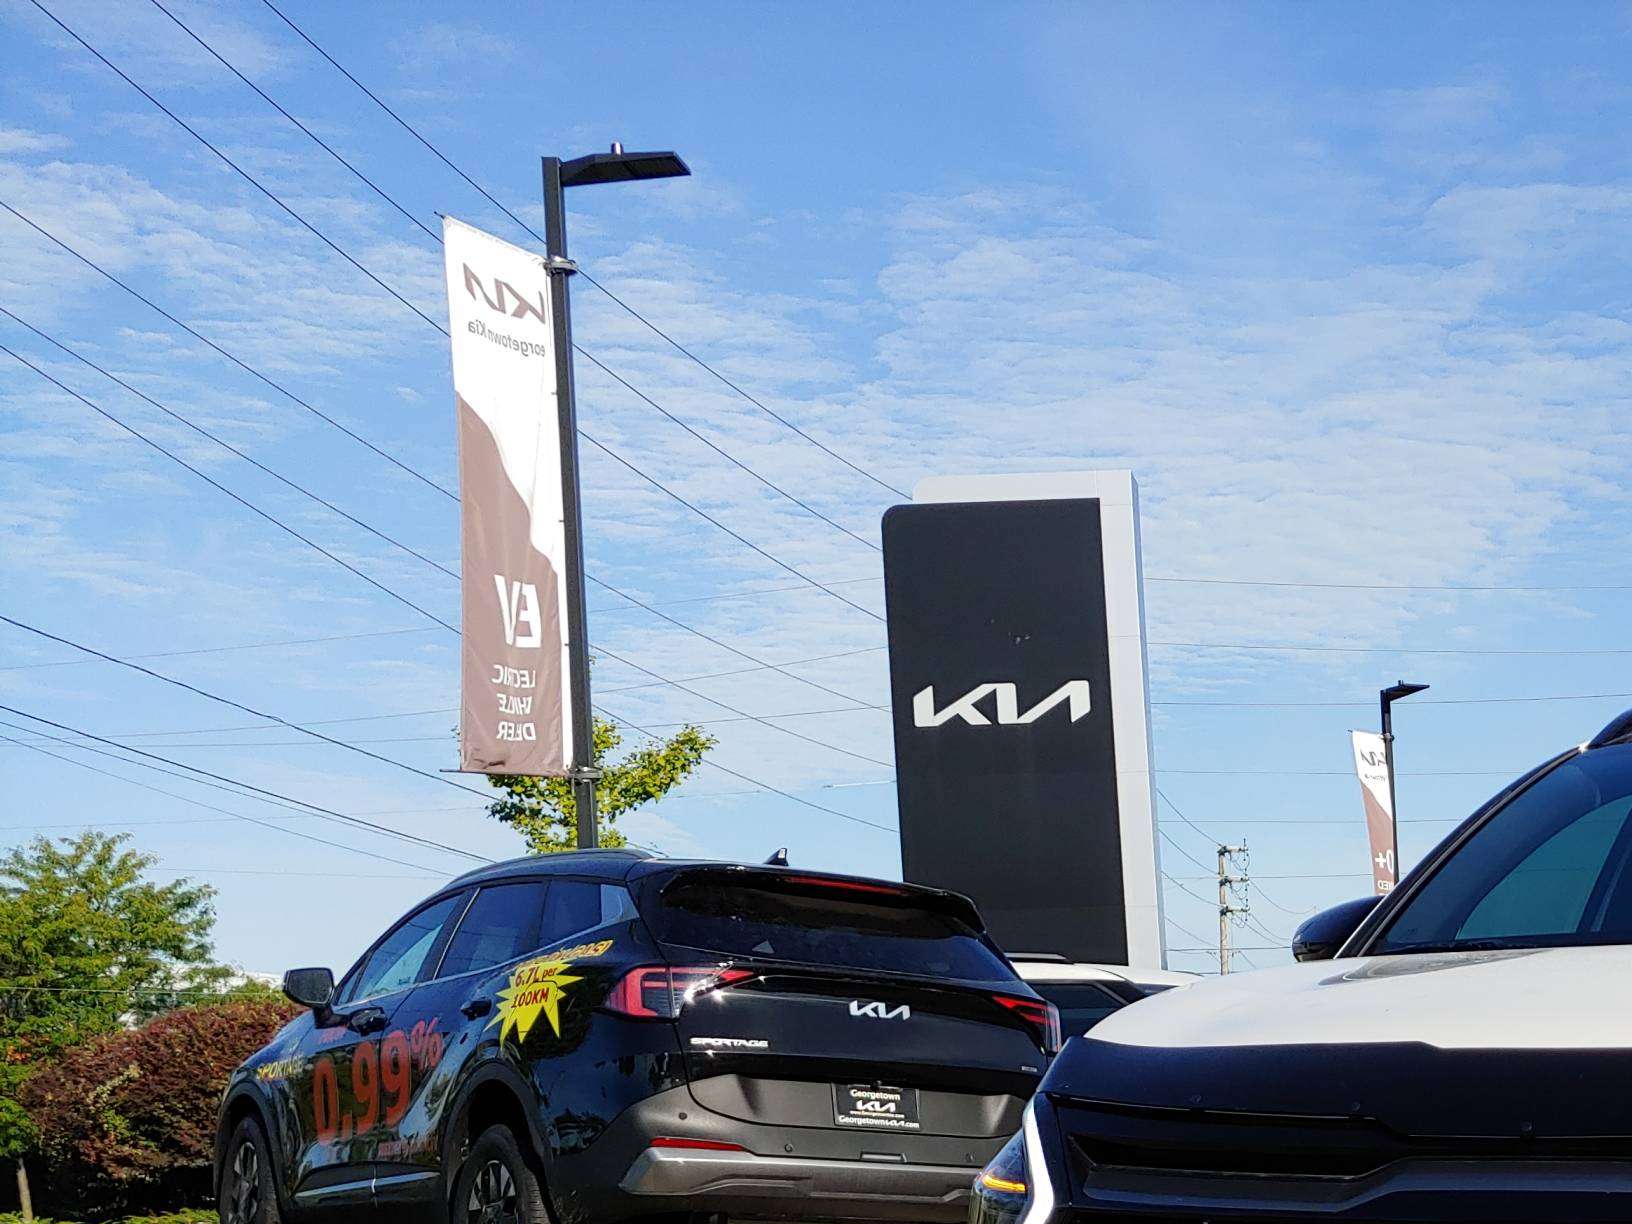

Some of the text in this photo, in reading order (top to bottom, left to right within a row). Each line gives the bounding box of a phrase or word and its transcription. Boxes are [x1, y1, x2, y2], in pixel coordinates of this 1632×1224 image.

[913, 680, 1091, 727] KIA
[542, 967, 558, 980] per
[511, 987, 550, 1009] 100KM
[849, 1000, 911, 1021] KIA
[690, 1037, 769, 1048] SPORTAGE
[313, 1017, 445, 1145] 0.99%
[850, 1089, 901, 1101] Georgetown
[856, 1100, 896, 1112] KIA
